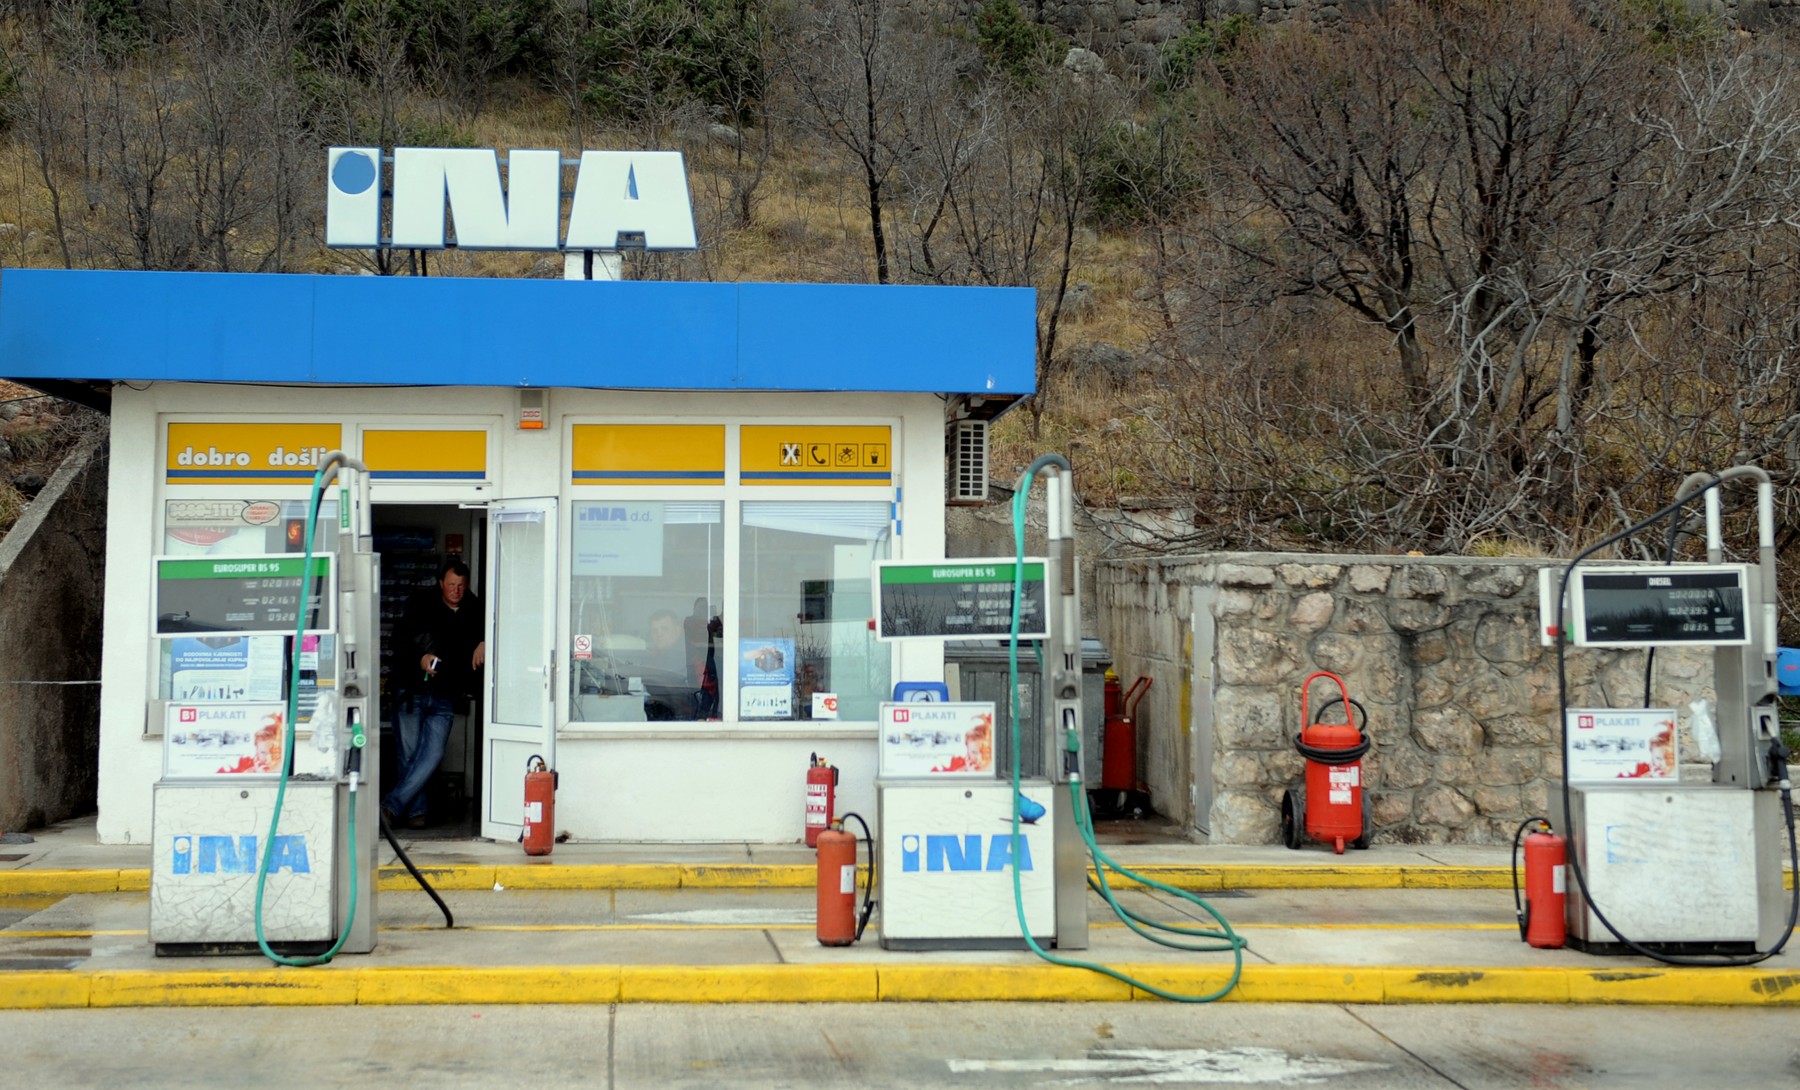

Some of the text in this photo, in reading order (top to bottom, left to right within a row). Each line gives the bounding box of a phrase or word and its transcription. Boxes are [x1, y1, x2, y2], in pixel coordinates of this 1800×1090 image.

[177, 446, 251, 466] dobro
[213, 563, 257, 573] EUROSUPER
[269, 562, 280, 572] 95
[932, 567, 996, 579] EUROSUPER BS 95
[1648, 577, 1672, 586] DIESEL
[181, 709, 246, 721] B1 PLAKATI
[911, 711, 956, 720] PLAKATI
[1596, 718, 1640, 727] PLAKATI
